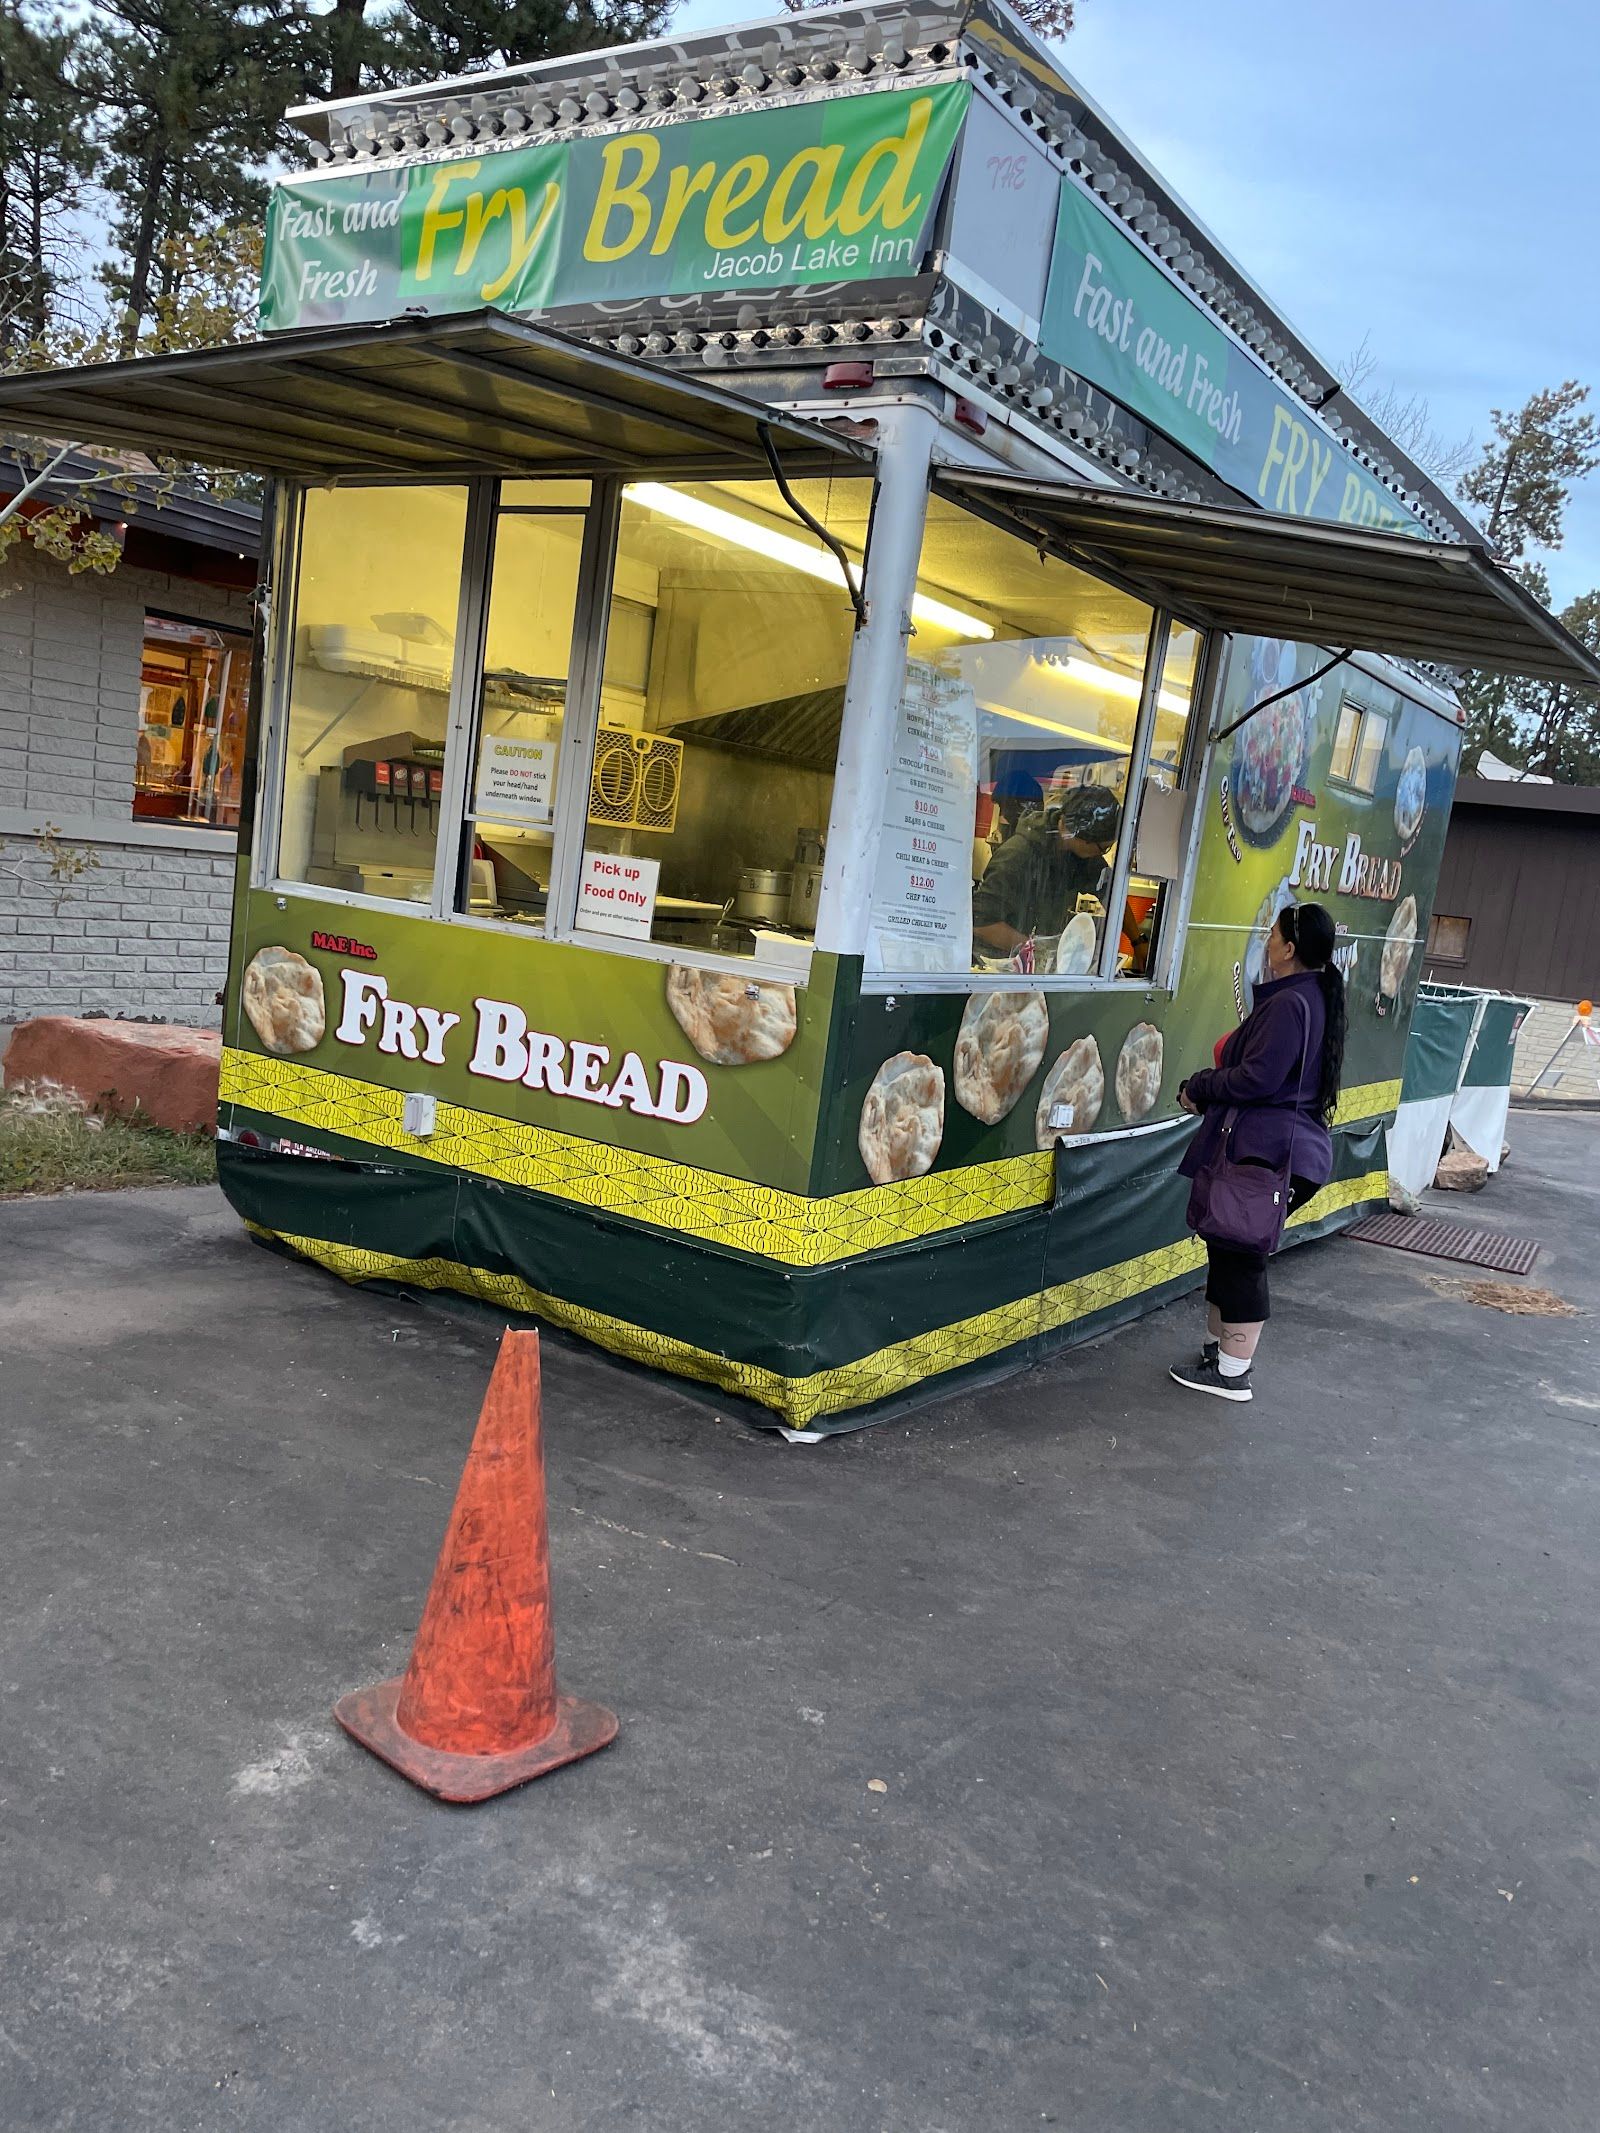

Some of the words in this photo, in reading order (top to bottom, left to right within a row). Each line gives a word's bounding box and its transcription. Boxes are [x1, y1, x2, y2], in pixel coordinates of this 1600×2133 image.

[415, 161, 560, 301] Fry
[583, 97, 933, 262] Bread
[280, 200, 335, 241] Fast
[343, 190, 406, 234] and
[703, 246, 783, 280] Jacob
[791, 239, 859, 271] Lake
[869, 234, 914, 265] Inn
[298, 259, 378, 301] Fresh
[1073, 253, 1134, 352] Fast
[1136, 327, 1188, 397] and
[1187, 354, 1242, 445] Fresh
[1258, 404, 1332, 516] FRY
[494, 745, 543, 760] CAUTION
[490, 767, 508, 776] Please
[509, 769, 519, 777] DO
[533, 772, 547, 780] stick
[507, 780, 539, 791] head/hand
[485, 791, 518, 800] underneath
[518, 795, 543, 803] window.
[915, 799, 938, 815] $10.00
[927, 821, 945, 832] CHEESE
[913, 837, 937, 852] $11.00
[895, 852, 911, 862] CHILI
[911, 855, 926, 864] MEAT
[931, 859, 949, 869] CHEESE
[1289, 819, 1340, 891] FRY
[1337, 832, 1402, 901] BREAD
[593, 860, 621, 876] Pick
[625, 868, 640, 881] up
[910, 875, 935, 888] $12.00
[584, 883, 615, 899] Food
[618, 889, 647, 907] Only
[905, 892, 921, 902] CHEF
[922, 895, 936, 904] TACO
[887, 916, 911, 925] GRILLED
[934, 922, 948, 930] WRAP
[313, 931, 348, 954] MAE
[350, 938, 377, 960] Inc.
[335, 967, 461, 1065] FRY
[467, 995, 709, 1125] BREAD
[305, 1145, 331, 1157] ARIZON
